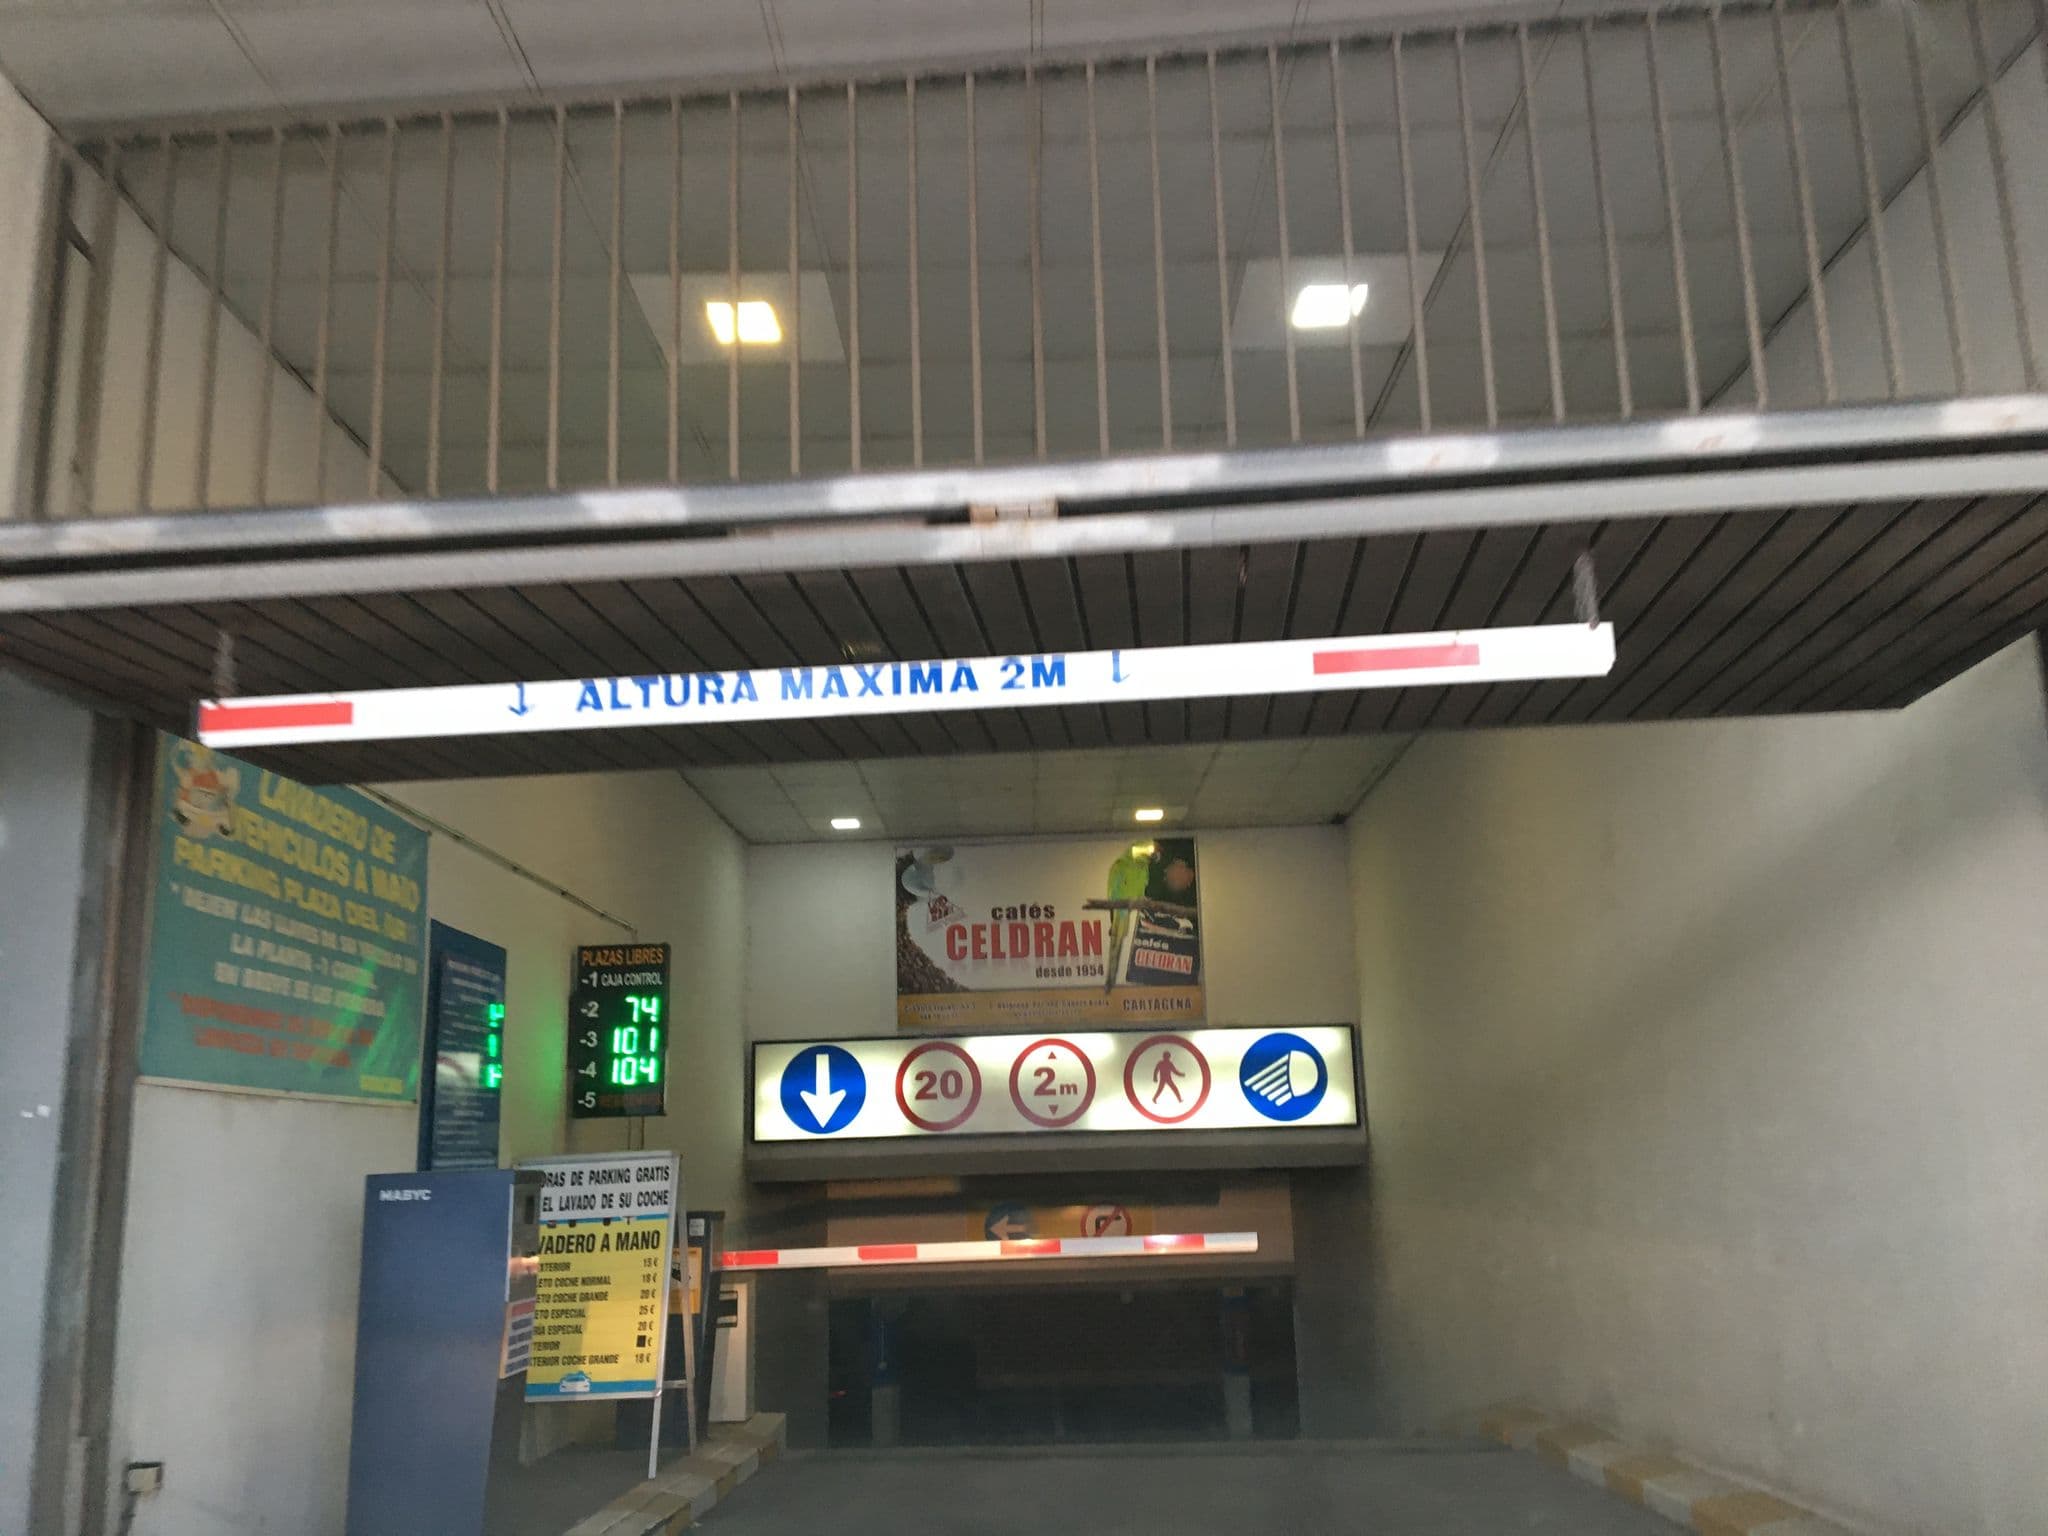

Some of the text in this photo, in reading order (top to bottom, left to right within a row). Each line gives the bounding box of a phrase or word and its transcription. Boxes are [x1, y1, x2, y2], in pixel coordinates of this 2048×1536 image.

[576, 654, 1067, 712] ALTURA MAXIMA 2M
[259, 769, 397, 865] LAVADERO DE
[230, 804, 350, 888] VEHICULOS
[353, 860, 369, 893] A
[284, 876, 342, 922] PLAZA
[991, 901, 1056, 920] cafés
[946, 920, 1102, 960] CELDRAN
[582, 947, 664, 966] PLAZAS LIBRES
[581, 971, 663, 988] -1 CAJA CONTROL
[1036, 964, 1104, 979] desde 1954
[580, 1001, 599, 1018] -2
[1122, 998, 1193, 1012] CARTAGENA
[579, 1031, 598, 1048] -3
[578, 1057, 659, 1086] -4 104
[914, 1069, 963, 1100] 20
[577, 1091, 596, 1108] -5
[570, 1170, 584, 1186] DE
[588, 1168, 631, 1185] PARKING
[636, 1166, 670, 1183] GRATIS
[542, 1190, 669, 1212] EL LAVADO DE SU COCHE
[600, 1232, 611, 1252] A
[616, 1230, 660, 1252] MANO
[554, 1277, 579, 1288] COCHE
[552, 1293, 577, 1303] COCHE
[579, 1291, 609, 1302] GRANDE
[551, 1308, 586, 1319] ESPECIAL
[547, 1324, 583, 1335] ESPECIAL
[561, 1354, 587, 1366] COCHE
[588, 1353, 618, 1365] GRANDE
